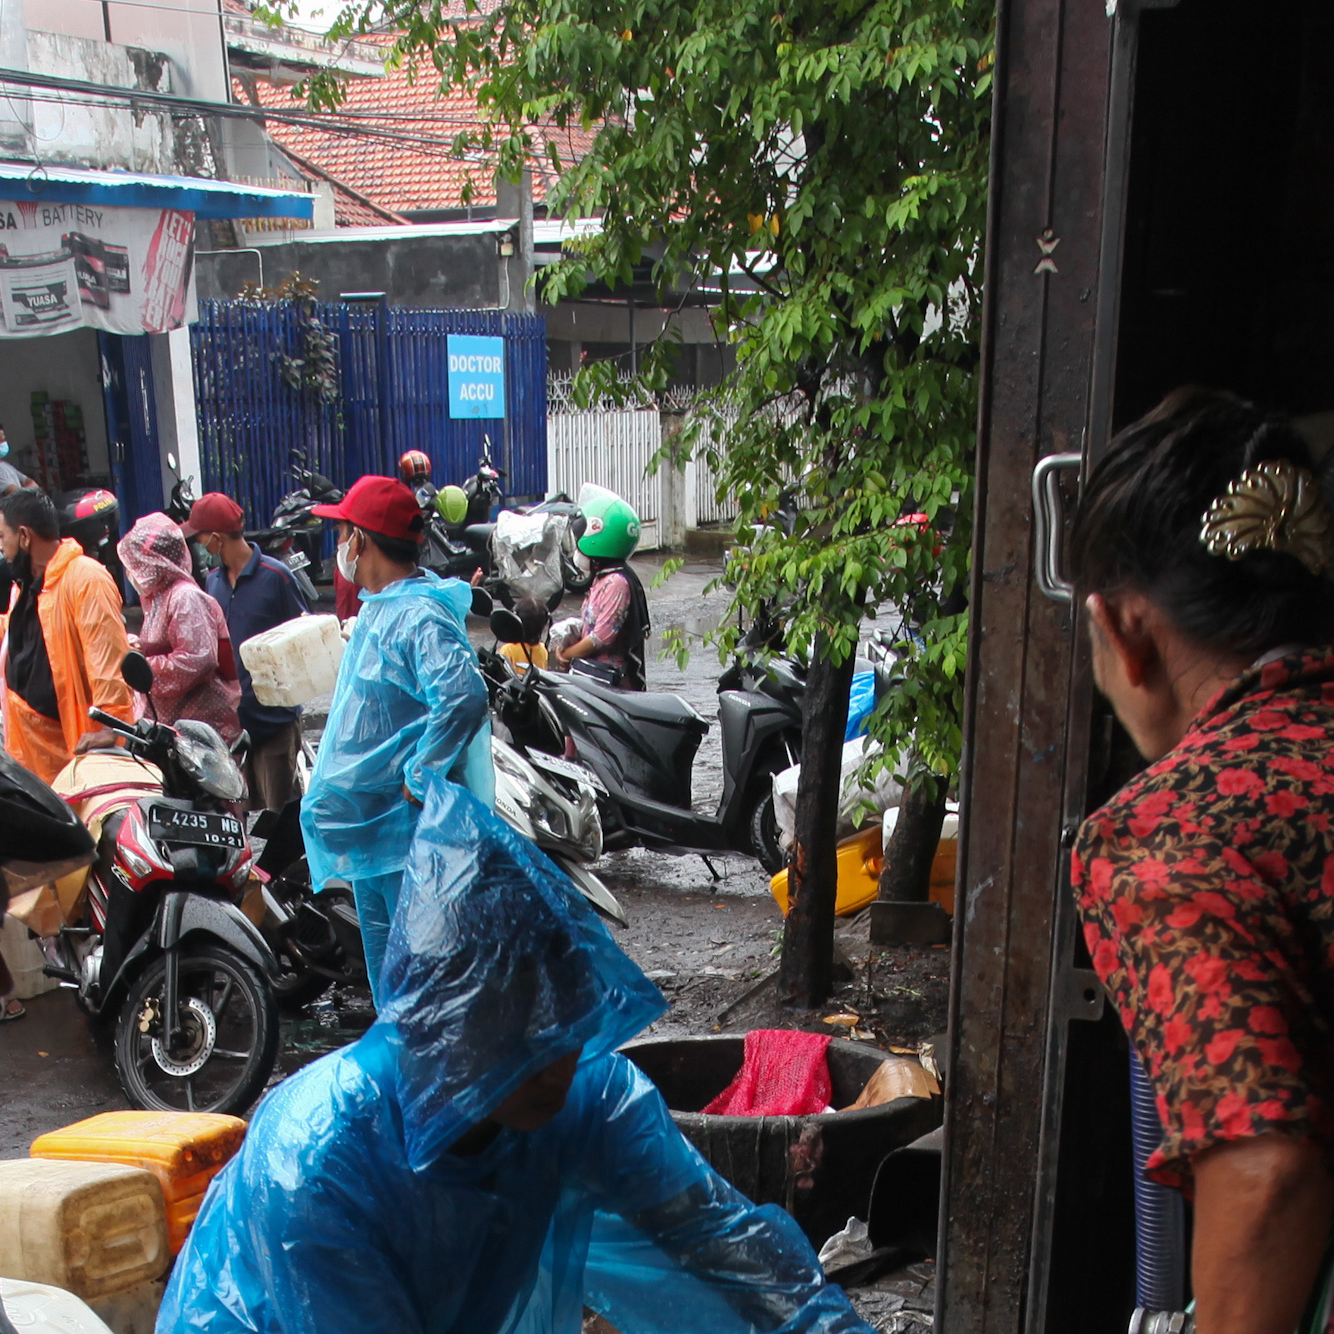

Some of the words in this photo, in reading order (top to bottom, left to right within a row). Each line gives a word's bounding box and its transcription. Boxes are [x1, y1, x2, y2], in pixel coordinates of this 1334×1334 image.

[42, 204, 103, 228] BATTERY
[27, 293, 58, 307] YUASA
[449, 354, 502, 373] DOCTOR
[459, 383, 495, 401] ACCU
[728, 693, 751, 708] HONDA
[496, 798, 517, 817] ONDA
[152, 808, 161, 823] L
[172, 812, 208, 829] 4235
[221, 818, 239, 833] NB
